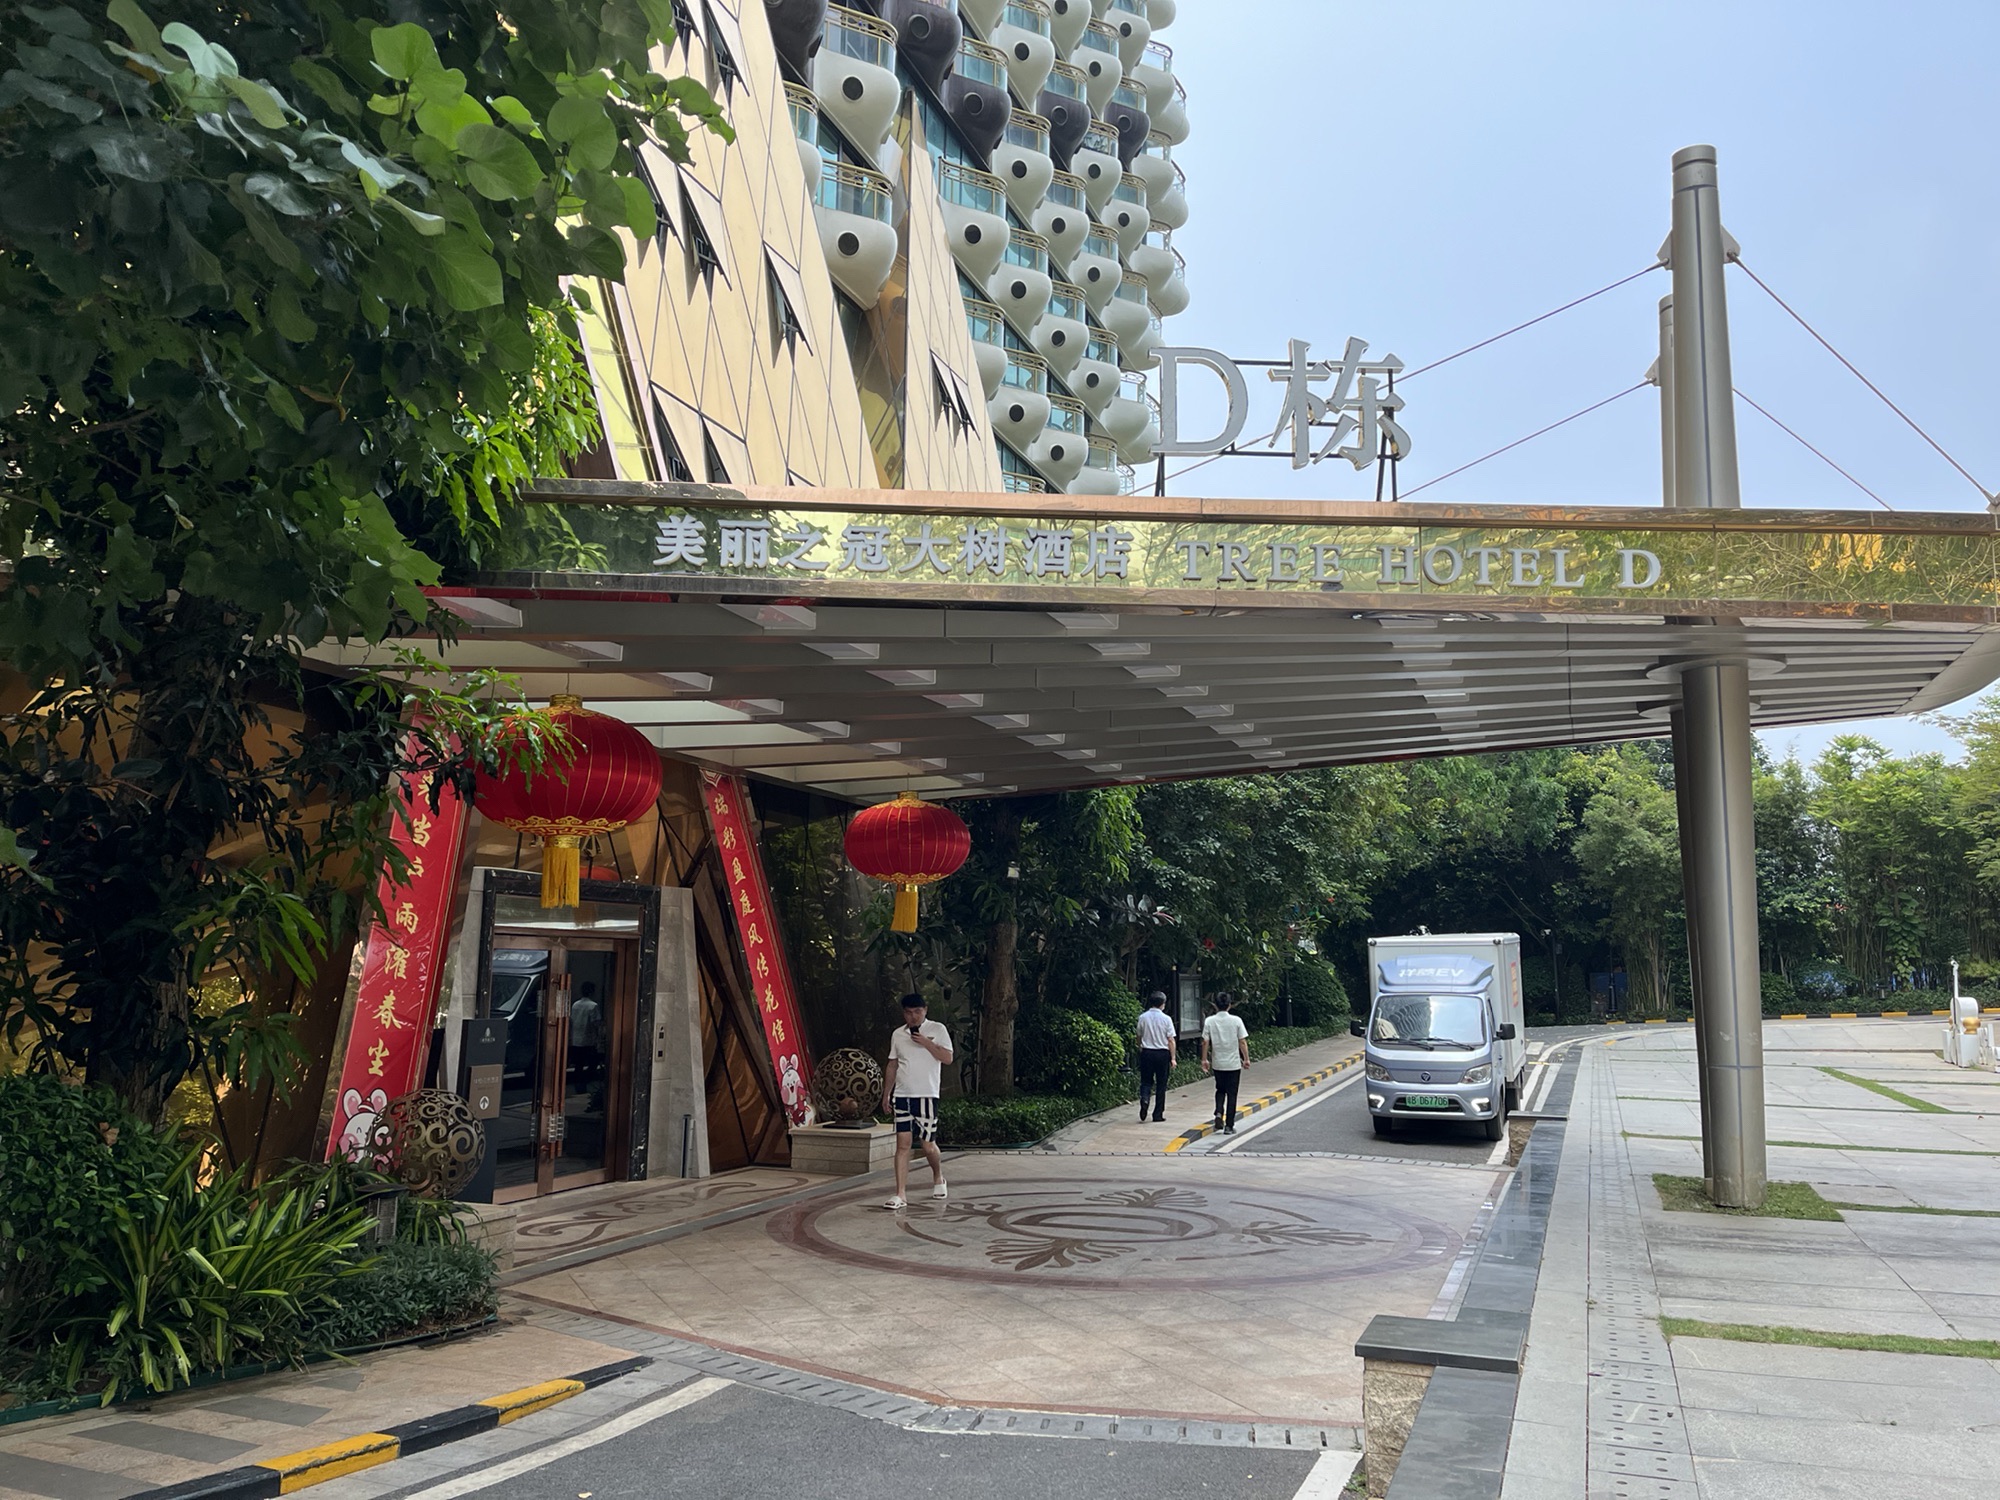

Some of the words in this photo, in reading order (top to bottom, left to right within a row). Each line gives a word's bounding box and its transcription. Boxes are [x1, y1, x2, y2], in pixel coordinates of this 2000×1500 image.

[1149, 336, 1411, 470] D栋
[653, 514, 1134, 579] 美丽之冠大树酒店
[1175, 540, 1343, 583] TREE
[1377, 545, 1585, 589] HOTEL
[1617, 549, 1662, 590] D
